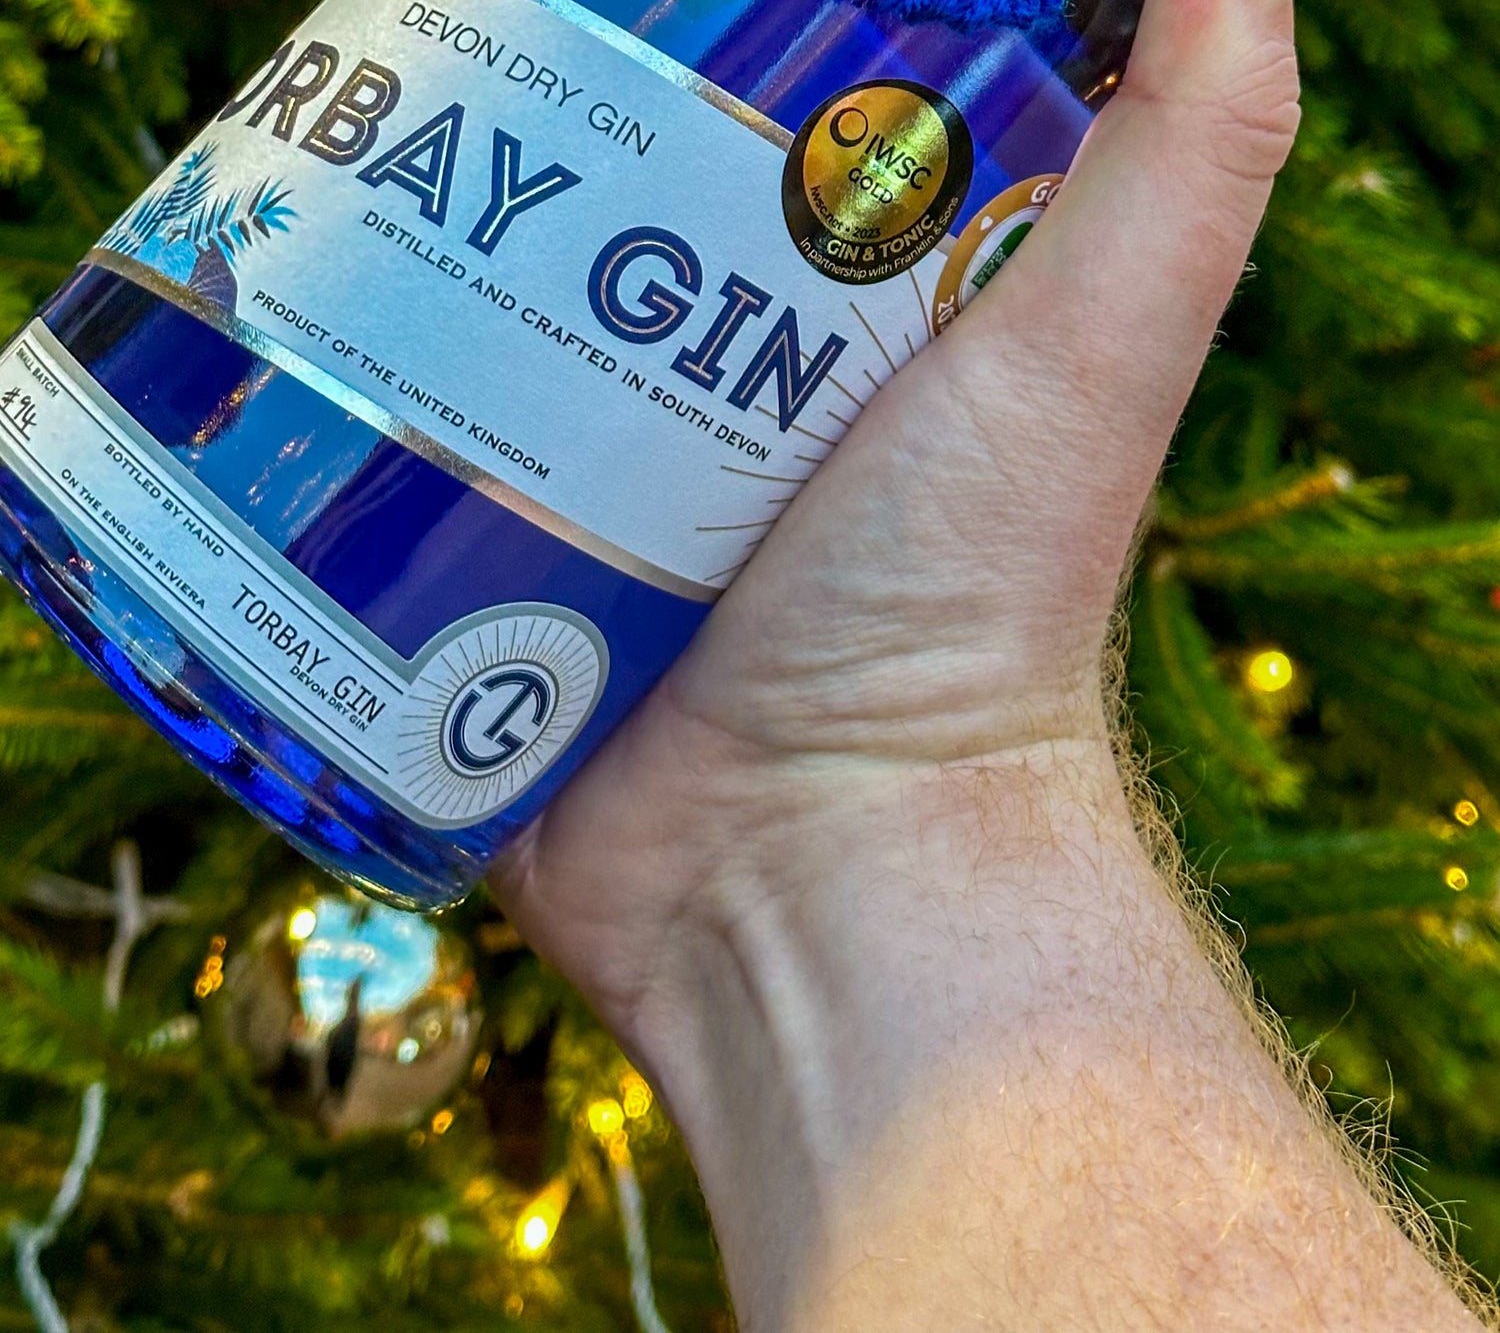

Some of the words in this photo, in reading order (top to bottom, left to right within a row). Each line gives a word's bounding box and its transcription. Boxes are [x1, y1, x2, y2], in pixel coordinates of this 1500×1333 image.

[400, 2, 506, 68] DEVON
[504, 53, 584, 110] DRY
[587, 102, 657, 158] GIN
[848, 167, 893, 204] GOLD
[865, 133, 932, 190] IWSC
[800, 236, 812, 253] In
[807, 249, 867, 281] partnership
[868, 262, 893, 277] with
[894, 235, 934, 269] Franklin
[939, 196, 959, 226] Sons
[826, 239, 860, 262] GIN
[862, 246, 875, 262] &
[879, 214, 934, 258] TONIC
[32, 367, 60, 398] BATCH
[252, 289, 331, 344] PRODUCT
[331, 338, 360, 360] OF
[358, 354, 395, 386] THE
[398, 380, 466, 428] UNITED
[467, 421, 552, 481] KINGDOM
[362, 210, 467, 281] DISTILLED
[468, 276, 517, 313] AND
[521, 307, 618, 375] CRAFTED
[621, 368, 647, 392] IN
[648, 385, 714, 431] SOUTH
[714, 423, 772, 463] DEVON
[586, 225, 850, 434] GIN
[61, 468, 78, 488] ON
[79, 487, 102, 512] THE
[102, 509, 154, 560] ENGLISH
[154, 558, 207, 610] RIVIERA
[103, 443, 161, 500] BOTTLED
[161, 497, 183, 518] BY
[182, 517, 225, 558] HAND
[231, 582, 331, 674] TORBAY
[333, 675, 387, 724] GIN
[289, 665, 329, 700] DEVON
[327, 696, 350, 716] DRY
[349, 714, 369, 733] GIN
